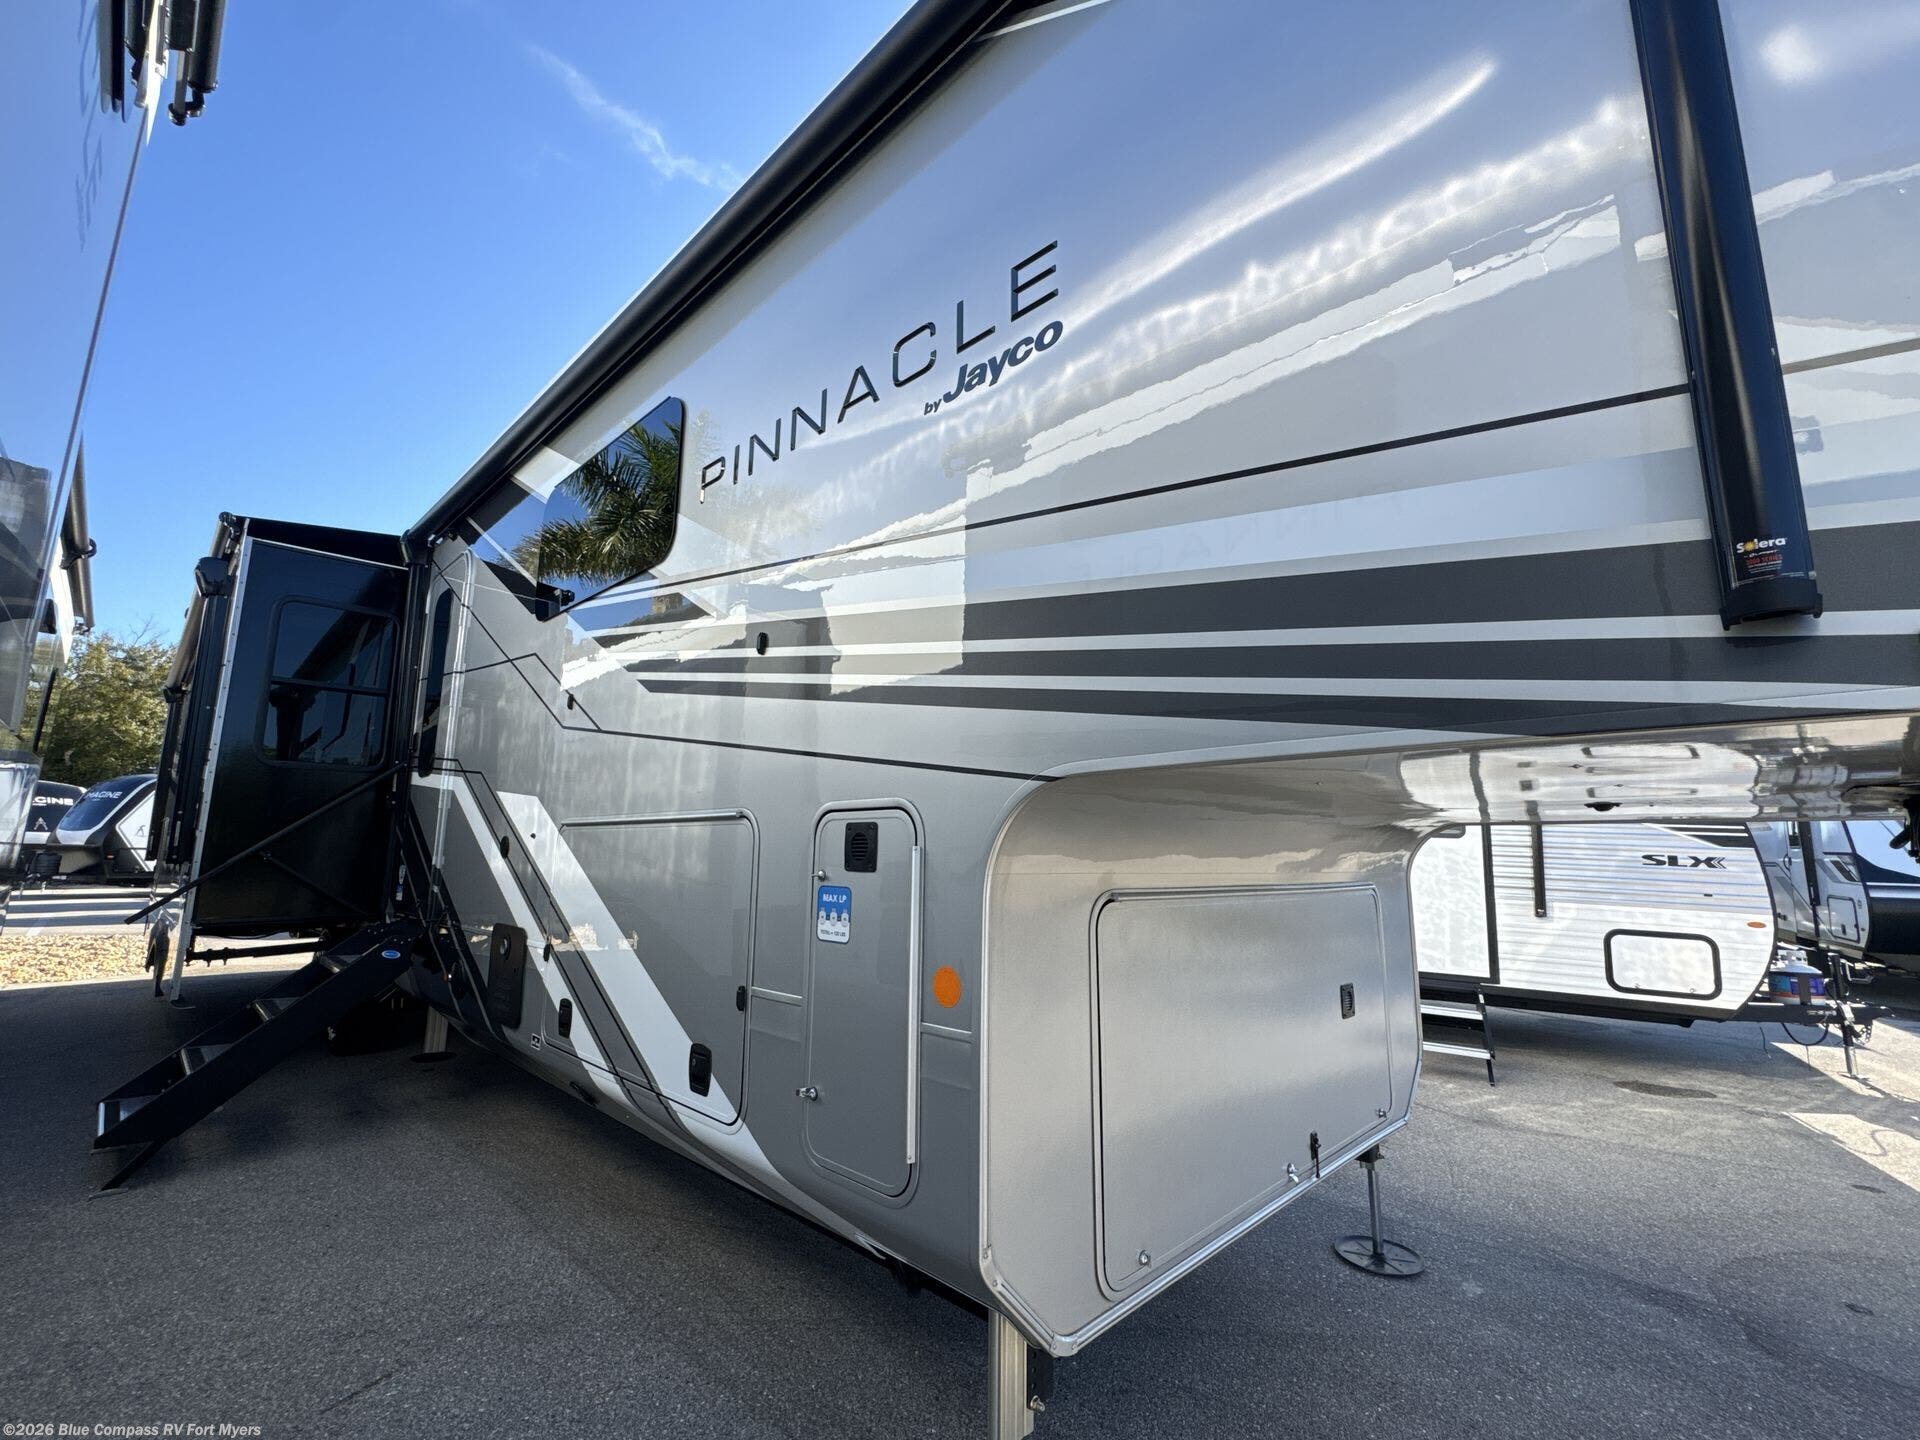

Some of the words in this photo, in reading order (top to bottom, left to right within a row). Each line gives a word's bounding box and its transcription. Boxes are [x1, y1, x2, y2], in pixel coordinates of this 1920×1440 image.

[700, 241, 1059, 504] PINNACLE
[923, 397, 942, 415] by
[942, 320, 1064, 403] Jayco
[1737, 538, 1786, 553] Solera
[32, 796, 74, 806] GINE
[1641, 854, 1727, 869] SLX
[823, 894, 838, 902] MAX
[838, 894, 847, 903] LP
